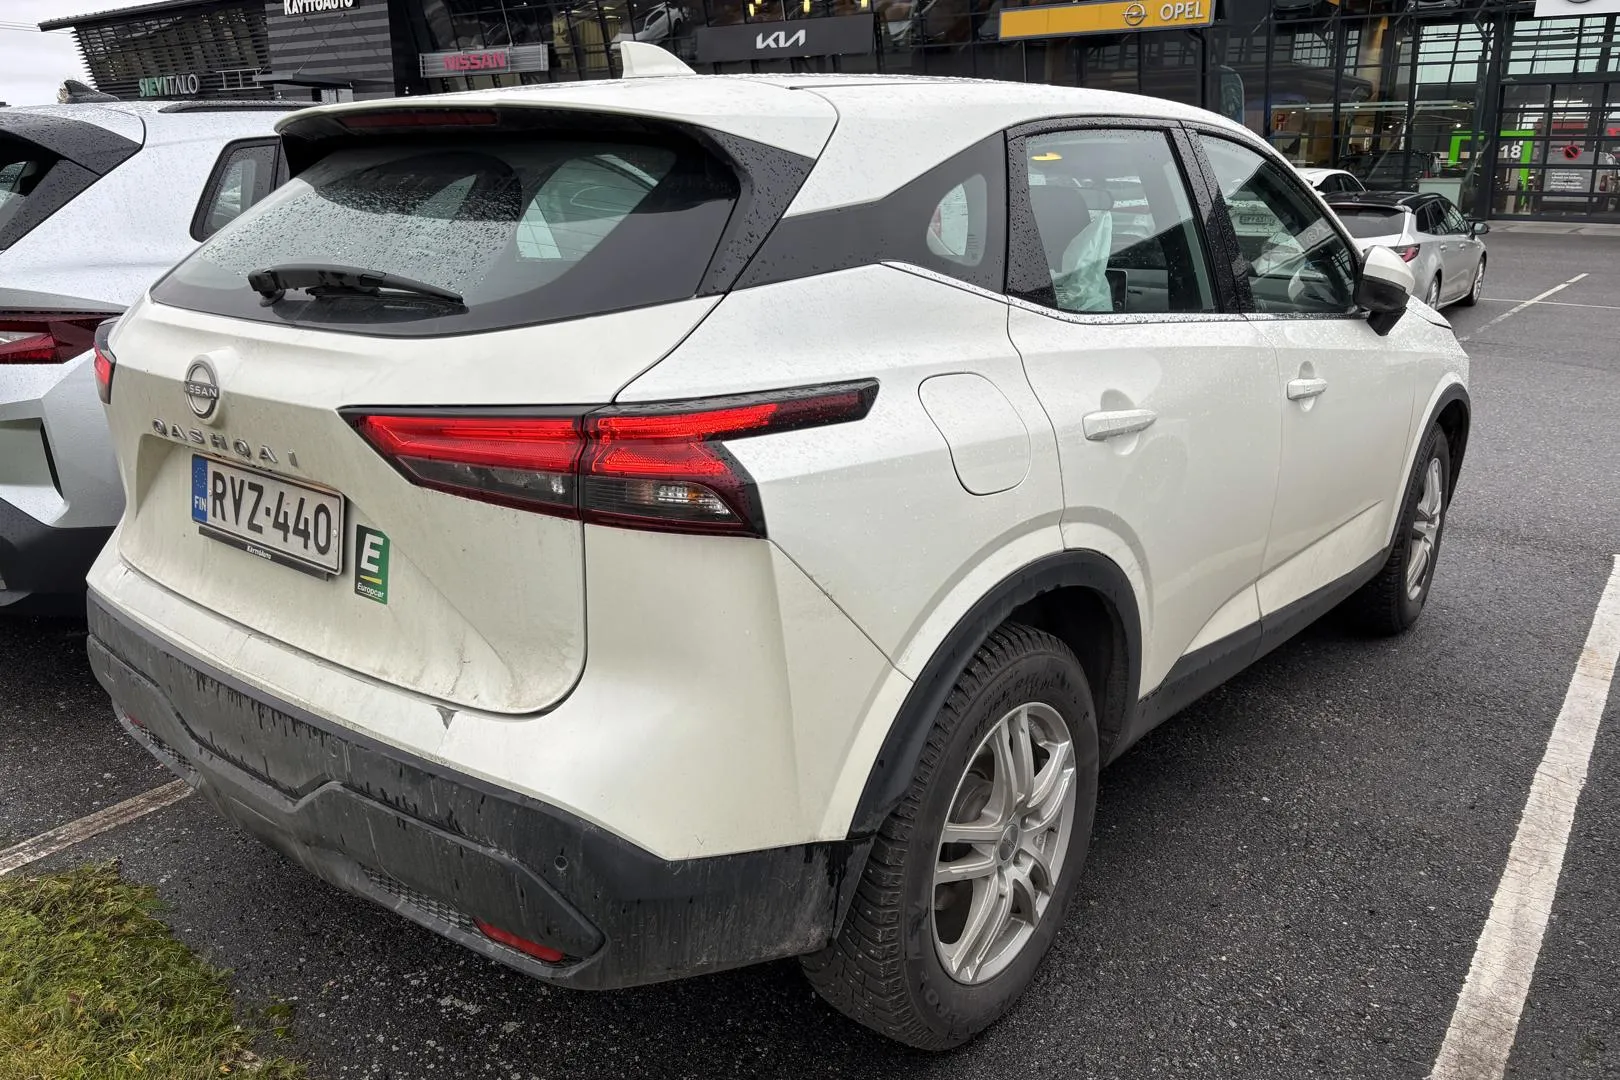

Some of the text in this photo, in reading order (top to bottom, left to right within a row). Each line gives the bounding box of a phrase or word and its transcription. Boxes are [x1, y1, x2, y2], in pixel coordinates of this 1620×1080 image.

[1160, 2, 1203, 20] OPEL
[756, 29, 806, 49] KIA
[443, 51, 505, 71] NISSAN
[139, 74, 198, 97] SIEVITALO
[1500, 144, 1521, 159] 18
[152, 417, 299, 469] QASHQAI
[194, 495, 207, 512] FIN
[212, 470, 332, 556] RVZ-440
[360, 532, 384, 574] E
[357, 582, 385, 598] Europcar
